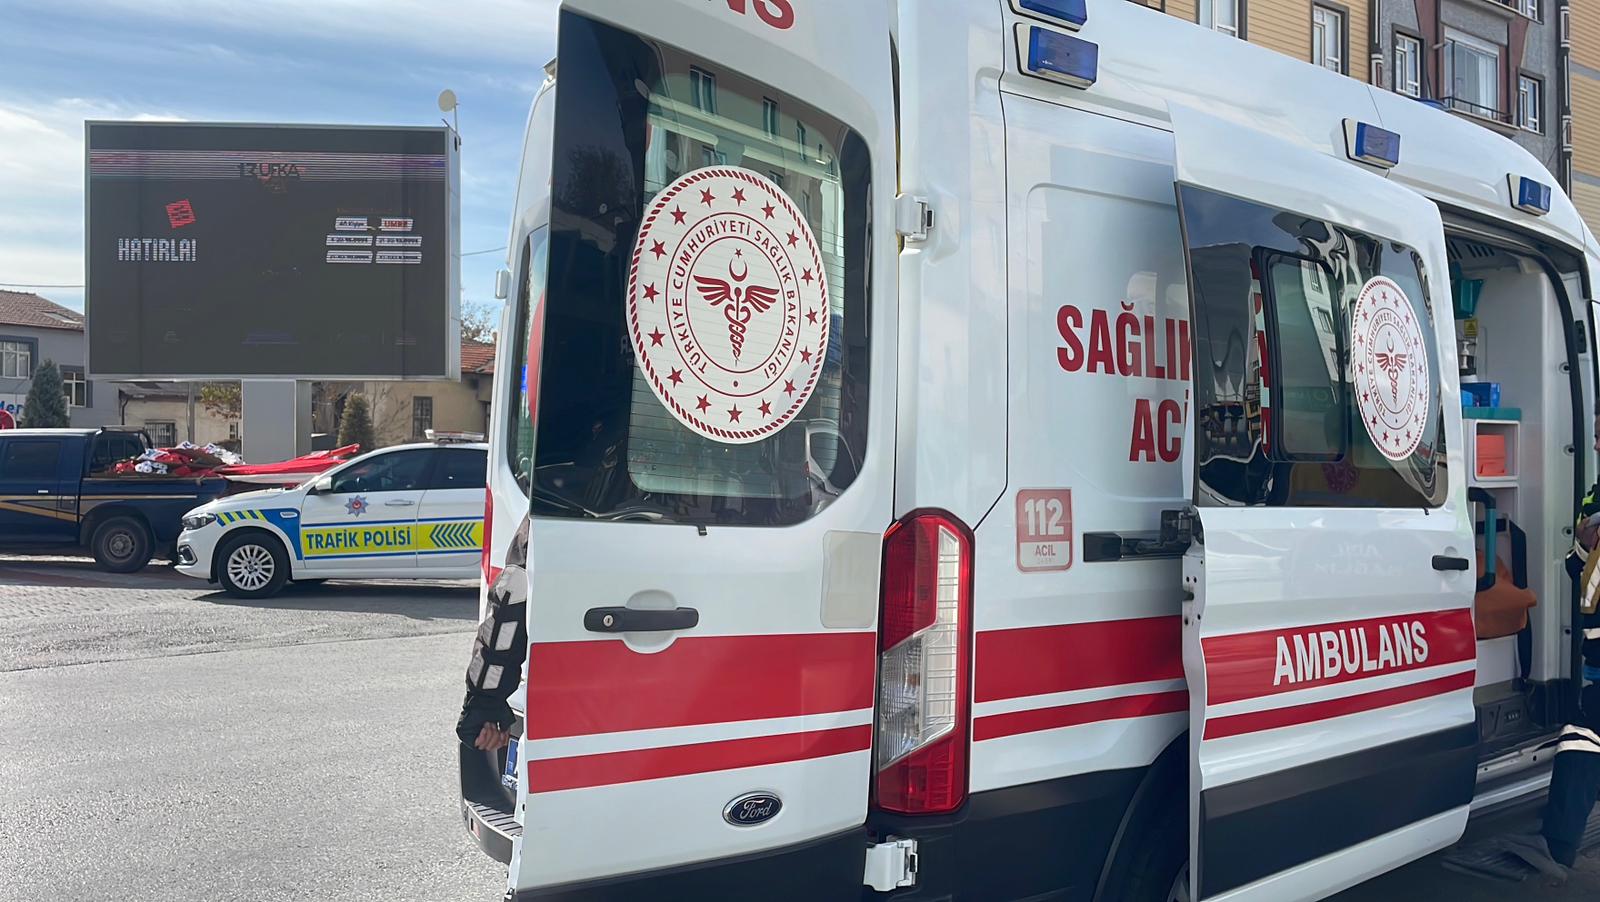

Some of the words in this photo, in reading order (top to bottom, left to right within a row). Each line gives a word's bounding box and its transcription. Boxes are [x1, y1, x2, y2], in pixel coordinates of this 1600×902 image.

[673, 219, 751, 290] CUMHURİYETİ
[754, 230, 792, 283] SAĞLIK
[672, 298, 707, 374] TÜRKİYE
[764, 291, 796, 380] BAKANLIĞI
[1129, 389, 1189, 463] AC
[306, 529, 359, 549] TRAFİK
[363, 526, 412, 547] POLİSİ
[1024, 498, 1065, 536] 112
[1273, 620, 1430, 686] AMBULANS
[740, 799, 773, 819] Ford
